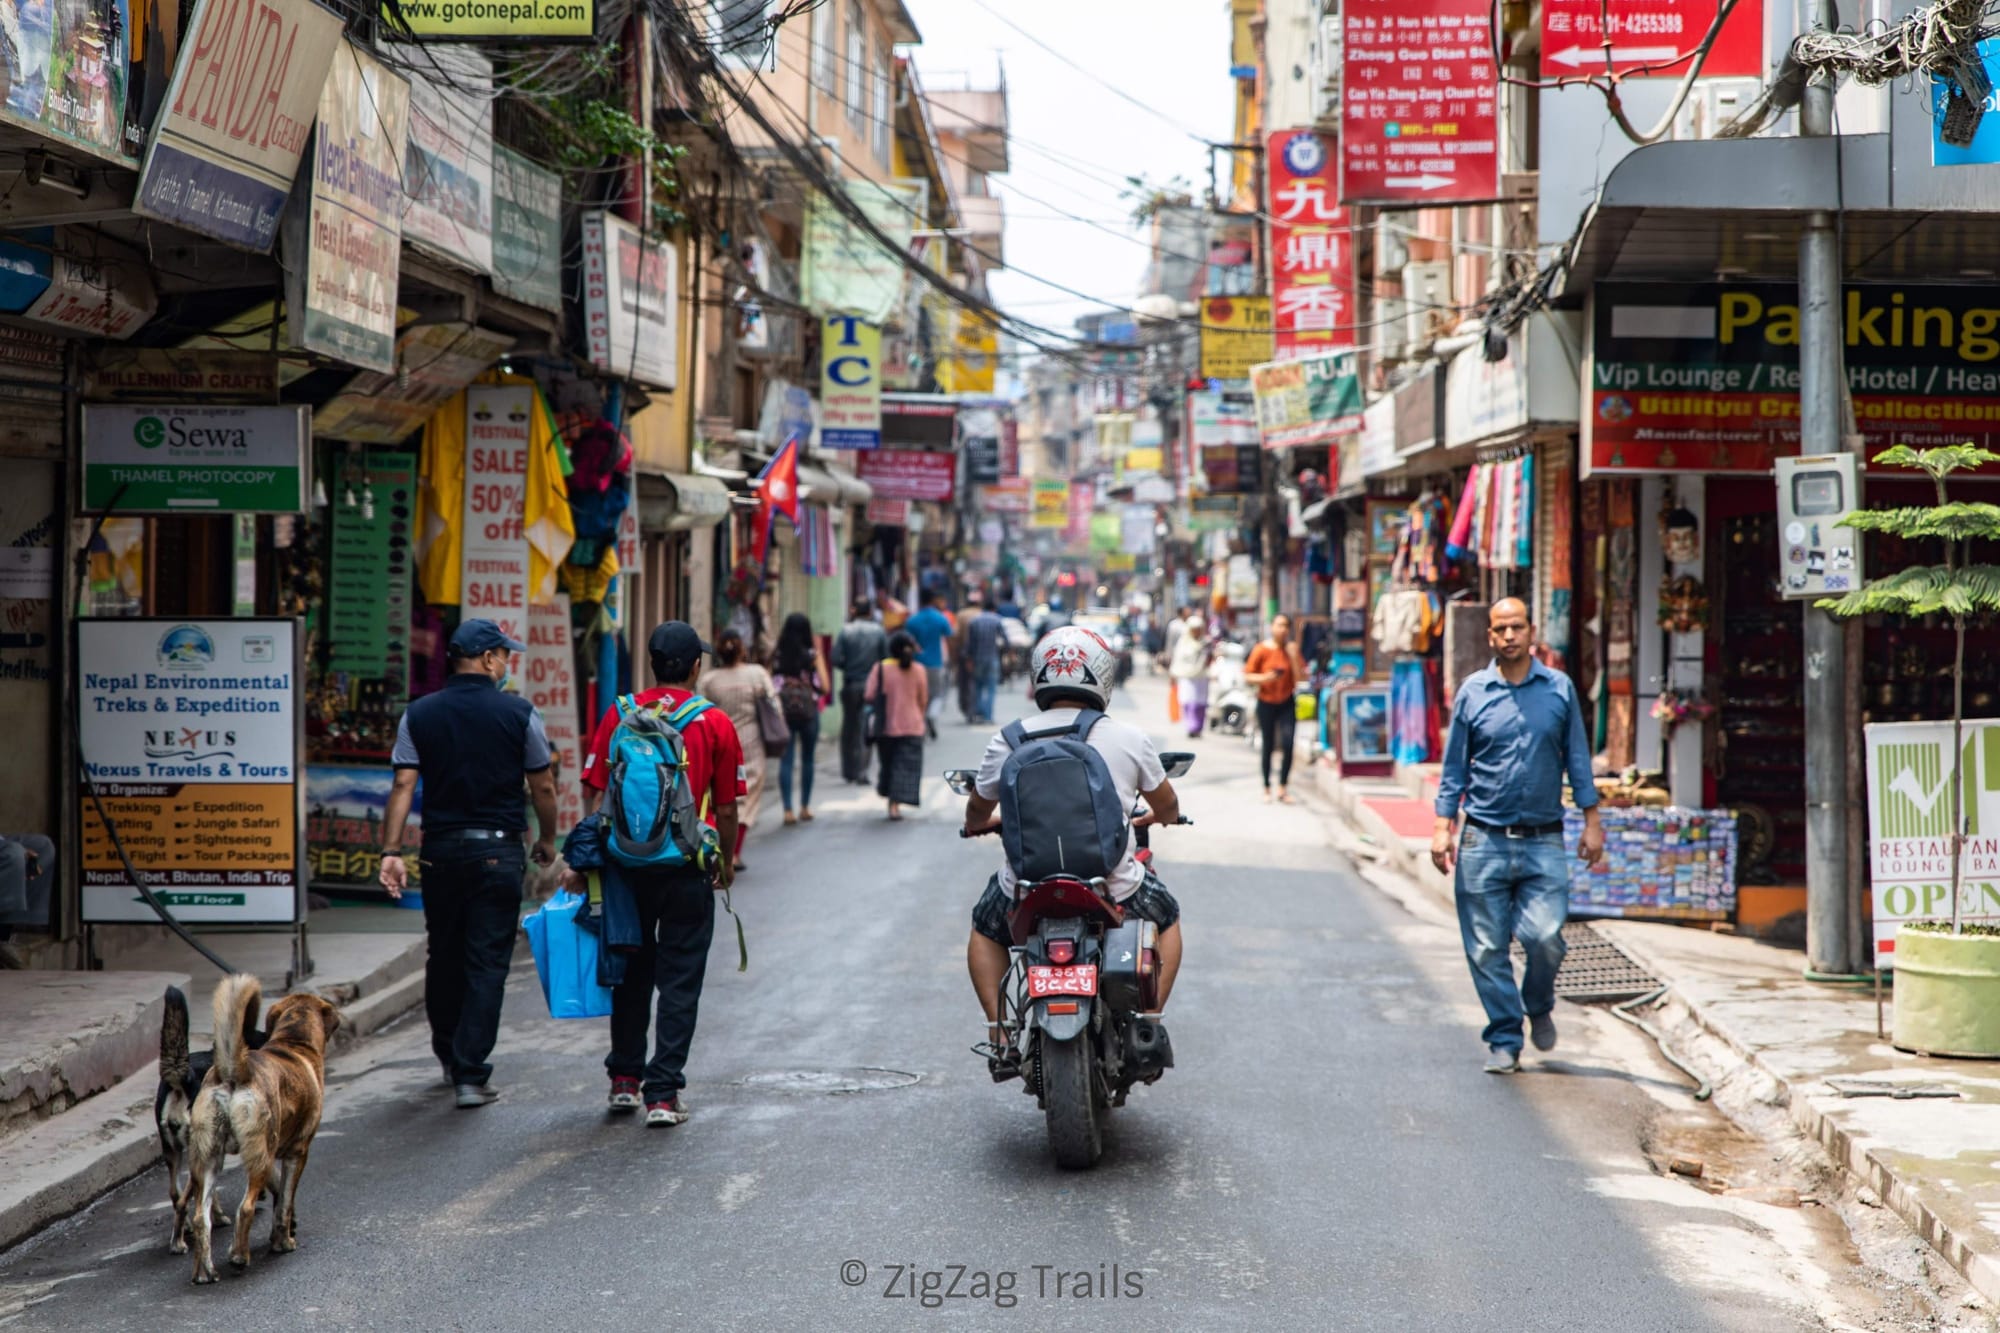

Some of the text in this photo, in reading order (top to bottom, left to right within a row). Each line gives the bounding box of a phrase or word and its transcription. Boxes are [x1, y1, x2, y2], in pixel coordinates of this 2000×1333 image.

[173, 0, 299, 150] PANDA
[586, 227, 605, 298] THIRD
[1276, 181, 1343, 331] 九鼎香
[1719, 291, 2000, 362] Paking
[591, 312, 608, 369] POLE
[209, 373, 274, 389] CRAFTS
[1597, 362, 1640, 390] Vip
[1647, 363, 1741, 391] Lounge
[1850, 366, 1917, 390] Hotel
[133, 416, 248, 449] eSewa
[472, 424, 528, 441] FESTIVAL
[472, 449, 527, 475] SALE
[111, 468, 277, 485] THAMEL PHOTOCOPY
[470, 484, 525, 514] 50%
[468, 559, 522, 575] FESTIVAL
[467, 583, 523, 609] SALE
[528, 625, 567, 646] ALE
[84, 673, 289, 693] Nepal Environmental
[93, 697, 281, 717] Treks & Expedition
[532, 691, 569, 708] off
[84, 763, 289, 778] Nexus Travels & Tours
[110, 784, 168, 796] Organize:
[106, 802, 264, 814] Trekking Expedition
[193, 819, 238, 830] Jungle
[242, 818, 281, 830] Safari
[194, 834, 272, 847] Sightseeing
[130, 851, 167, 863] Flight
[195, 851, 224, 861] Tour
[227, 851, 290, 863] Packages
[1880, 860, 1946, 874] LOUNG
[86, 871, 129, 885] Nepal,
[172, 871, 225, 885] Bhutan,
[227, 871, 262, 883] India
[264, 871, 291, 884] Trip
[193, 895, 235, 904] Floor
